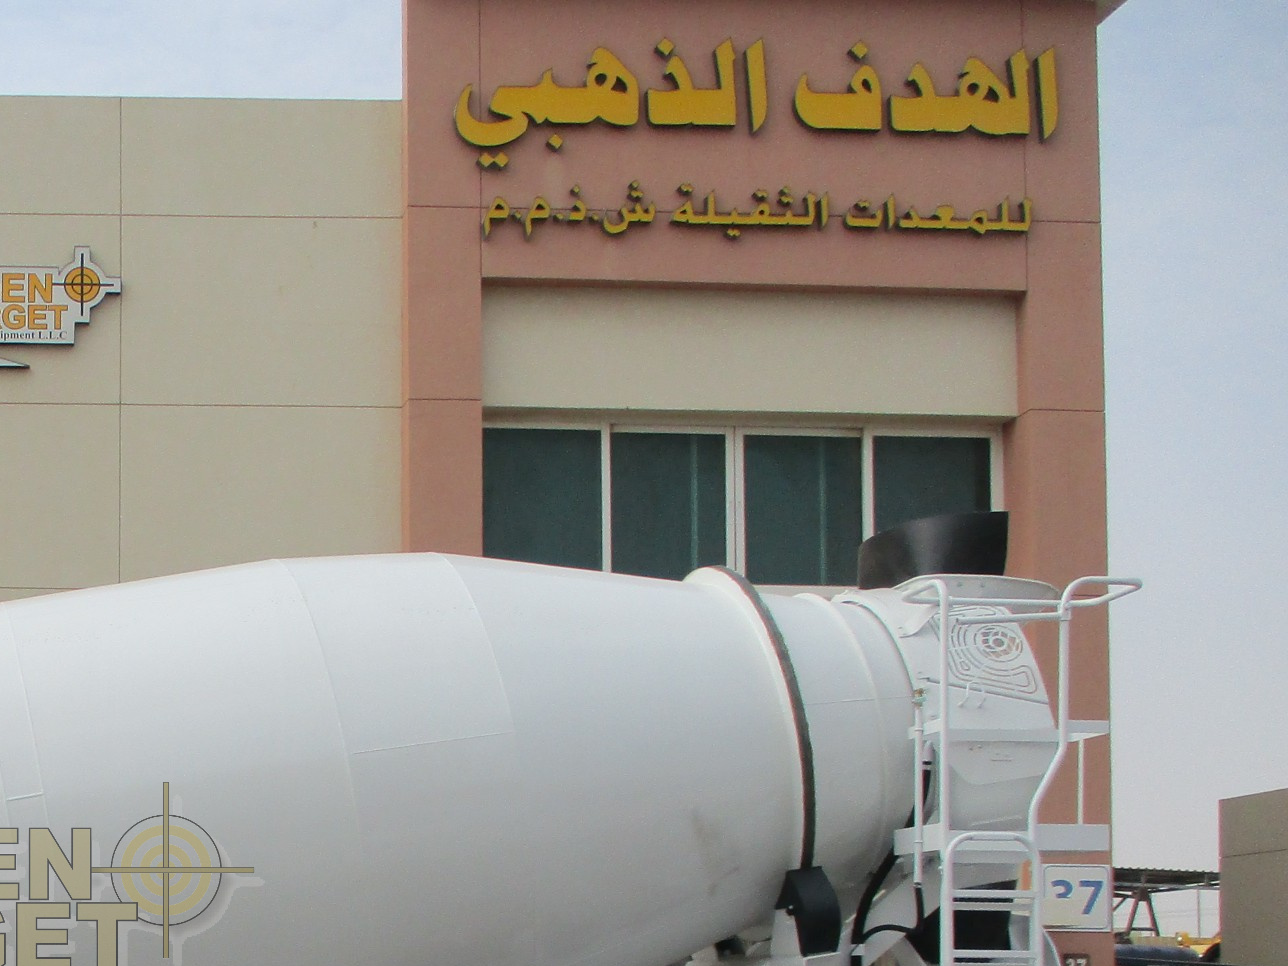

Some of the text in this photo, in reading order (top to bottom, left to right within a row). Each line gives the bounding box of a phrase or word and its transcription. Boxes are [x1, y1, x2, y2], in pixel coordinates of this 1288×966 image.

[453, 37, 1058, 170] الهدف الذهبي
[671, 181, 829, 240] الثقيلة
[844, 193, 1032, 234] للمعدات
